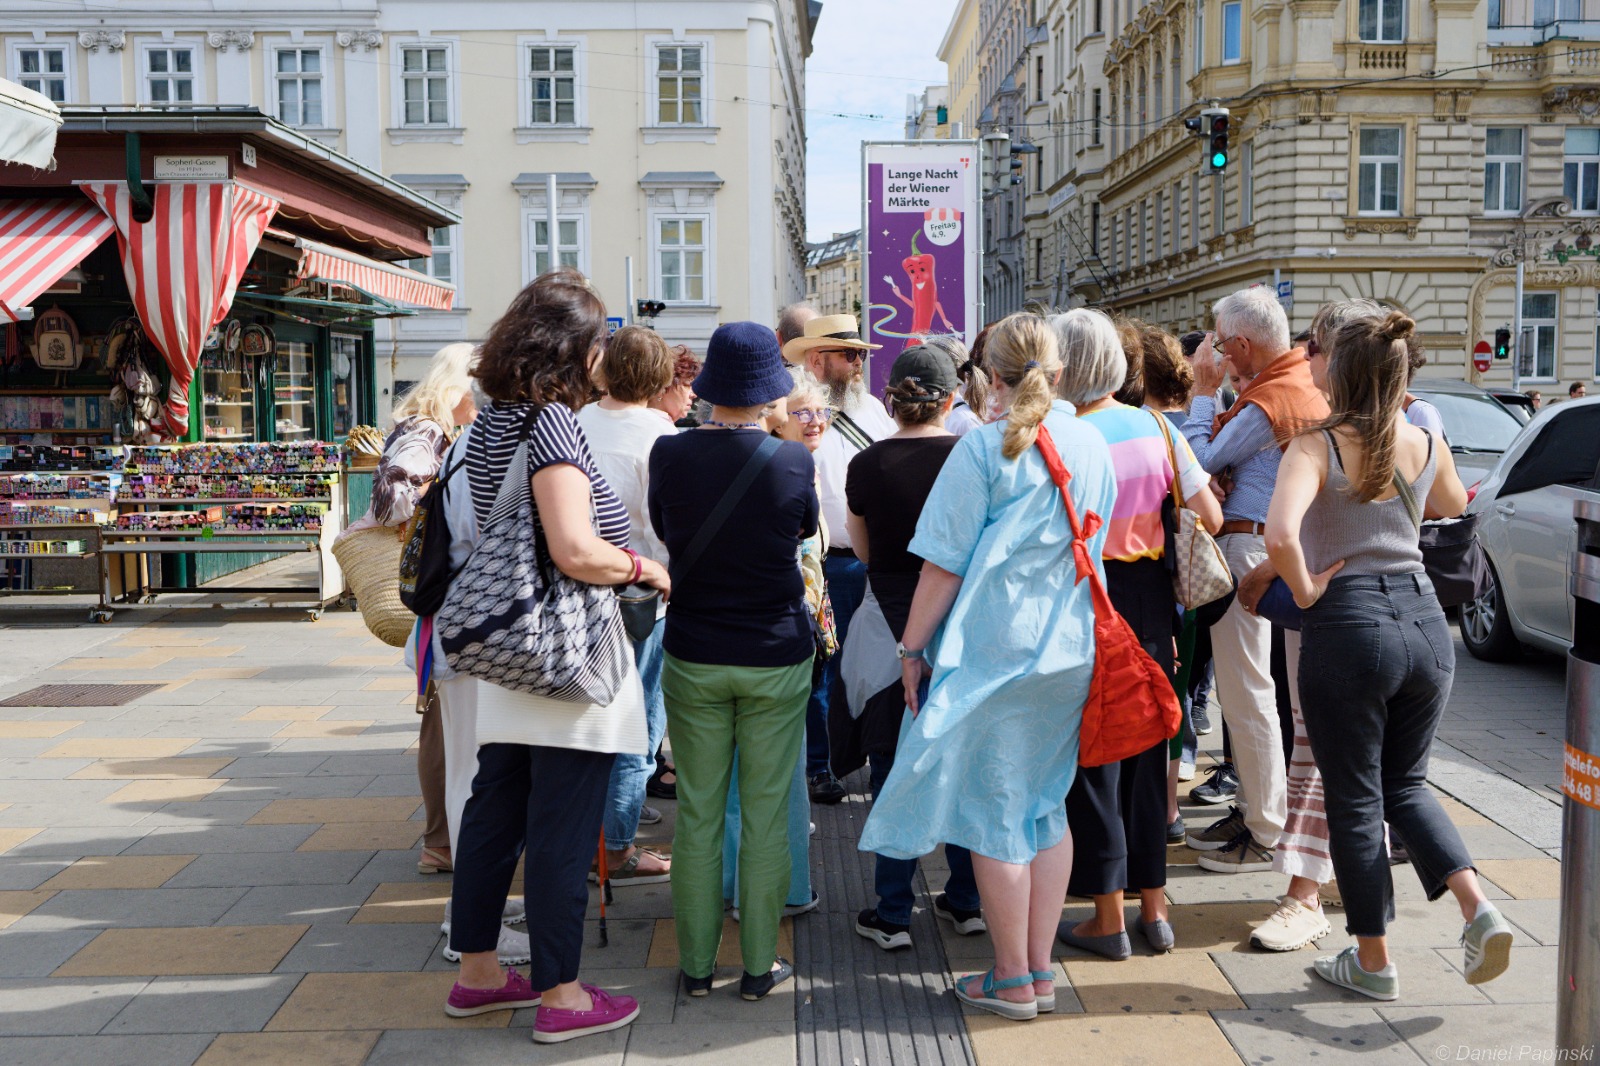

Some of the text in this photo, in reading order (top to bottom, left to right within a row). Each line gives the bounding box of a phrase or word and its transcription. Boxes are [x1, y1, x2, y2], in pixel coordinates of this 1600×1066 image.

[888, 169, 958, 181] Lange Nacht
[888, 183, 950, 193] der Wiener
[888, 197, 930, 206] Märkte
[930, 222, 956, 231] Freitag
[932, 230, 946, 238] 4.9.
[1576, 782, 1592, 802] 48
